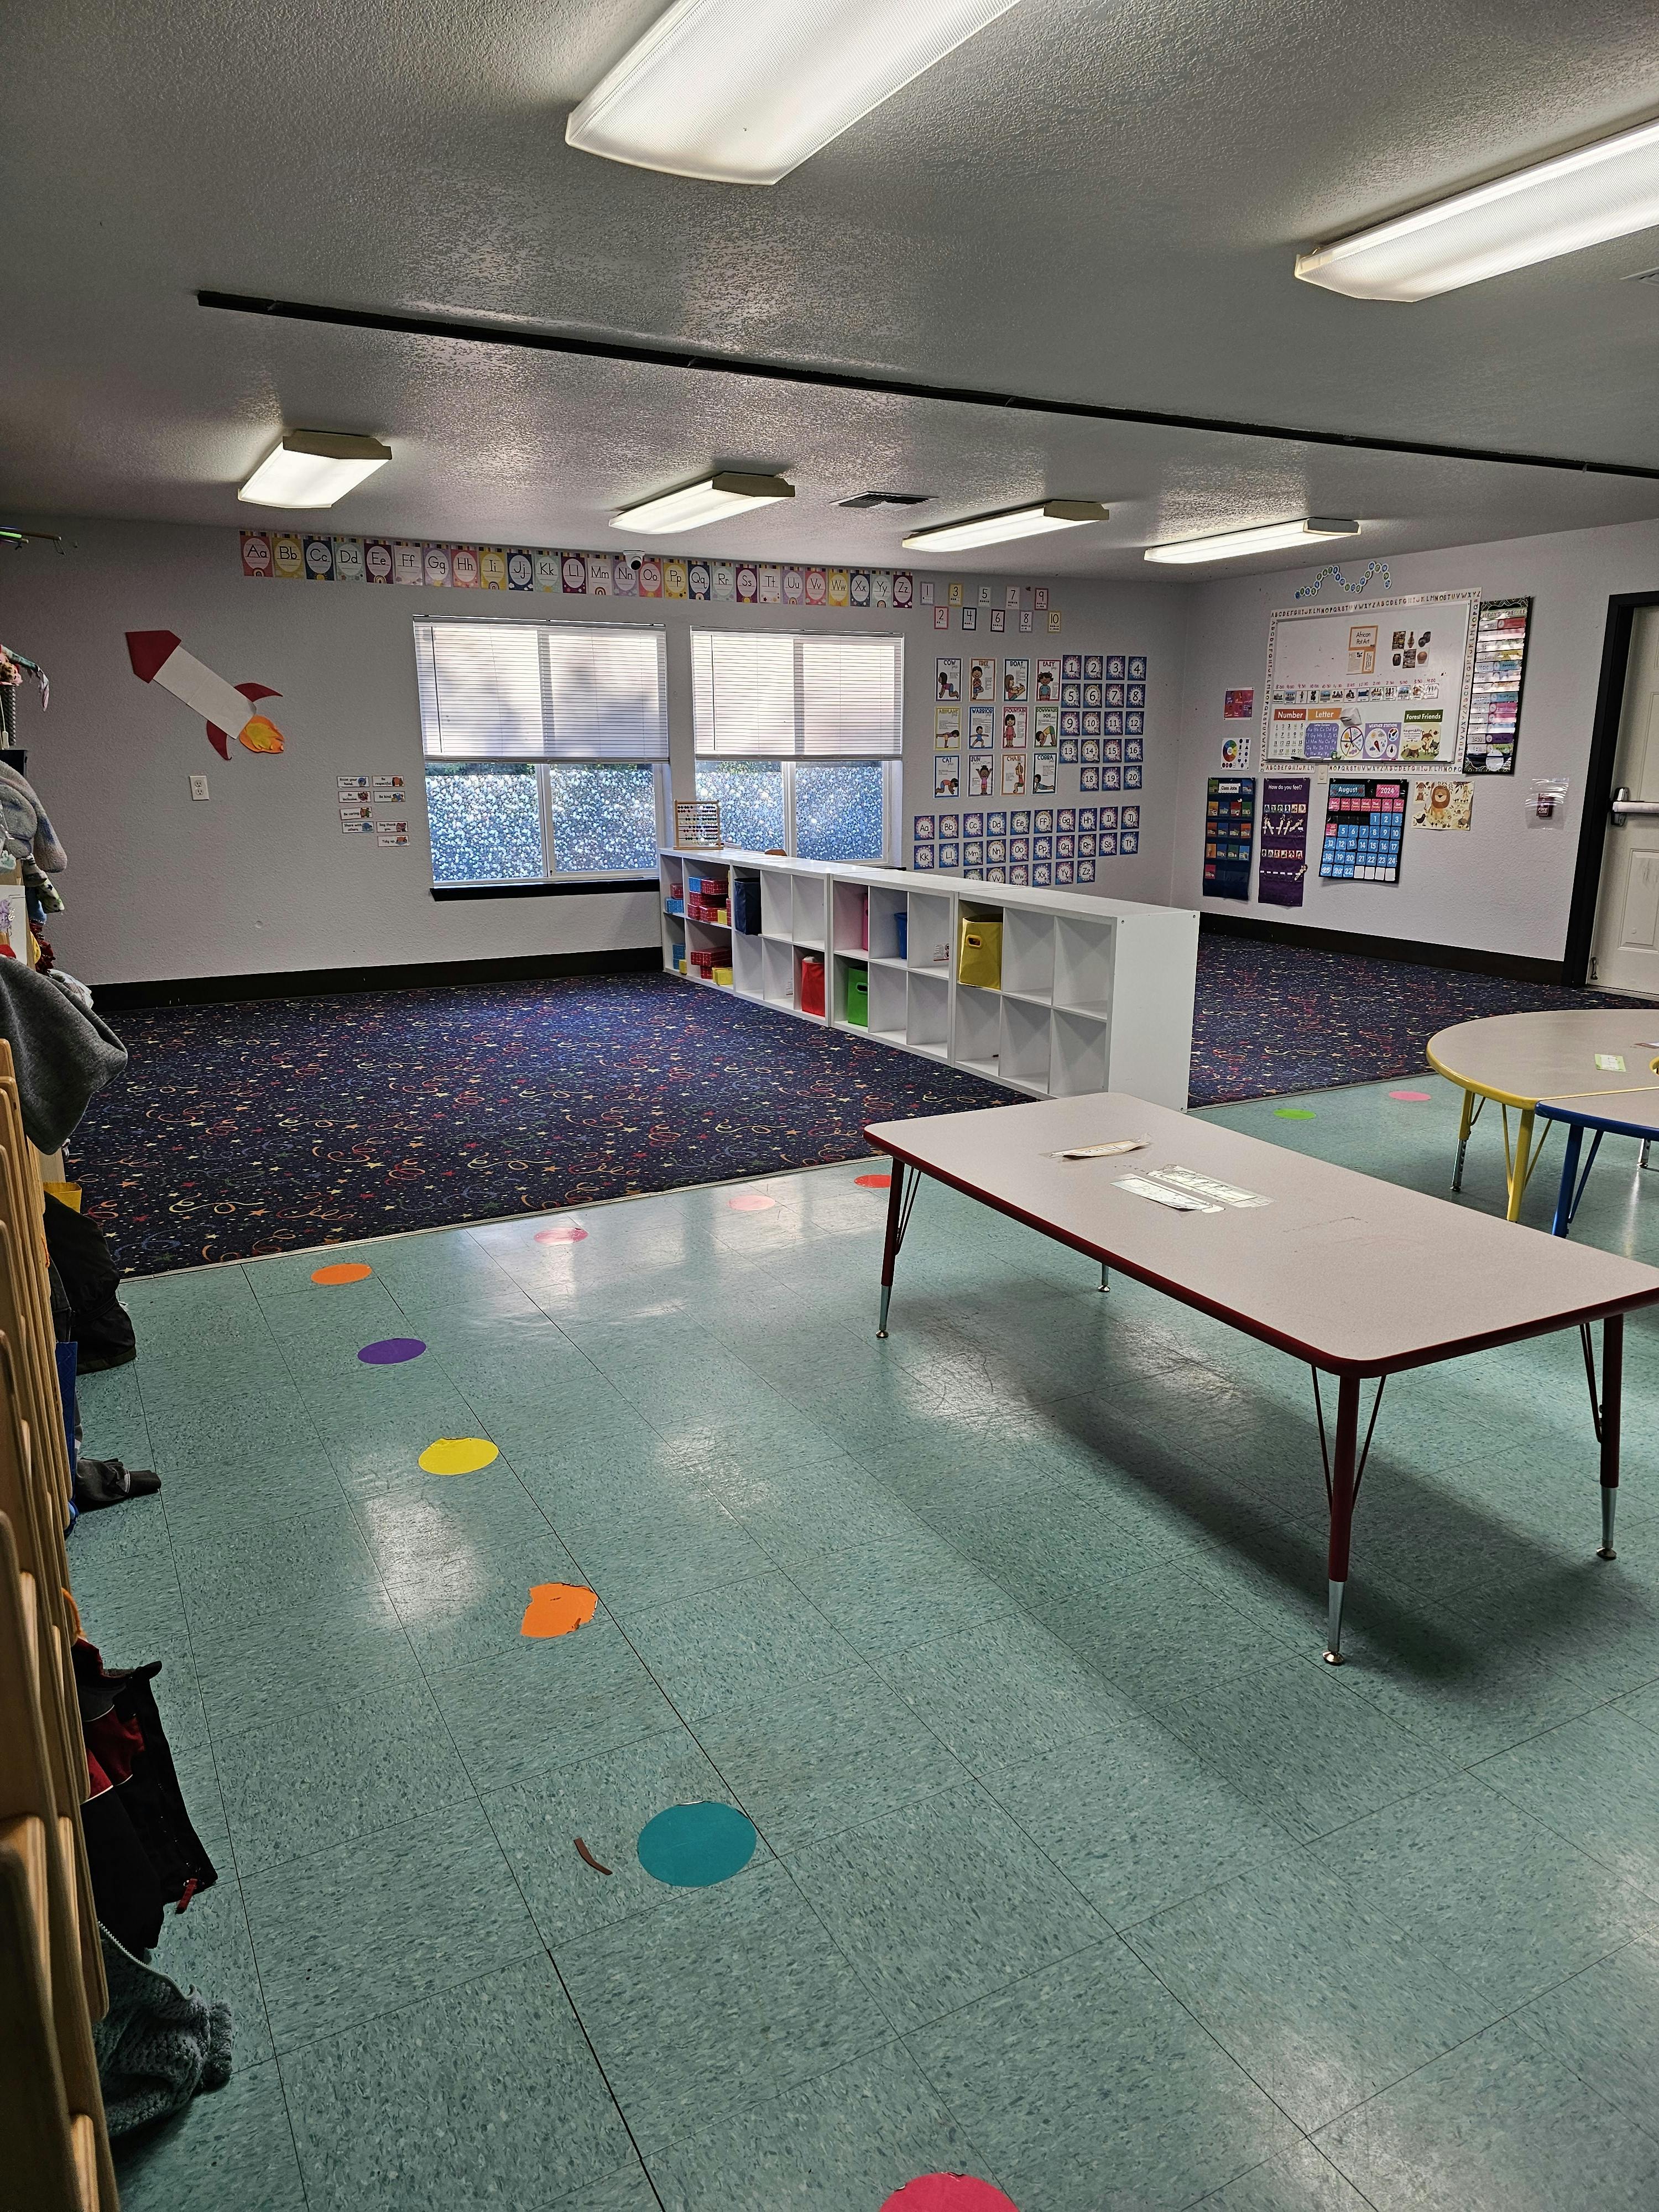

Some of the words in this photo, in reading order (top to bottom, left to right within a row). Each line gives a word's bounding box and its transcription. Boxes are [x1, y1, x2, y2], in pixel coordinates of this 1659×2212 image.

[247, 545, 267, 558] Aa
[279, 546, 297, 560] Bb
[310, 549, 327, 562] Cc
[340, 550, 358, 564] Dd
[372, 552, 386, 565] Ee
[402, 554, 414, 566] Ff
[457, 557, 473, 570] Hh
[428, 556, 445, 574] Gg
[489, 560, 496, 572] Ii
[514, 561, 525, 579] Jj
[540, 562, 554, 576] Kk
[569, 565, 578, 577] Ll
[591, 566, 609, 578] Mm
[619, 567, 632, 580] Nn
[643, 569, 658, 581] Oo
[670, 571, 681, 587] Pp
[691, 572, 707, 588] Qq
[718, 573, 729, 585] Rr
[742, 575, 752, 587] Ss
[765, 576, 775, 587] Tt
[787, 578, 799, 588] Uu
[811, 578, 821, 590] Vv
[832, 580, 846, 591] Ww
[855, 581, 866, 592] Xx
[877, 581, 887, 597] Yy
[899, 582, 908, 593] Zz
[953, 586, 958, 597] 3
[982, 588, 988, 598] 5
[1011, 589, 1016, 599] 7
[1039, 591, 1044, 601] 9
[939, 609, 944, 620] 2
[967, 611, 972, 621] 4
[995, 613, 1000, 623] 6
[1024, 613, 1029, 623] 8
[1051, 614, 1059, 624] 10
[1070, 663, 1074, 672] 1
[1090, 663, 1096, 673] 2
[1113, 663, 1119, 672] 3
[1134, 664, 1140, 674] 4
[1068, 692, 1074, 701] 5
[1089, 691, 1095, 701] 6
[1112, 691, 1118, 700] 7
[1133, 691, 1139, 701] 8
[1067, 718, 1073, 728] 9
[1062, 817, 1070, 825] Gg
[1128, 814, 1133, 823] Jj
[1039, 845, 1046, 853] Pp
[1061, 843, 1070, 852] Qq
